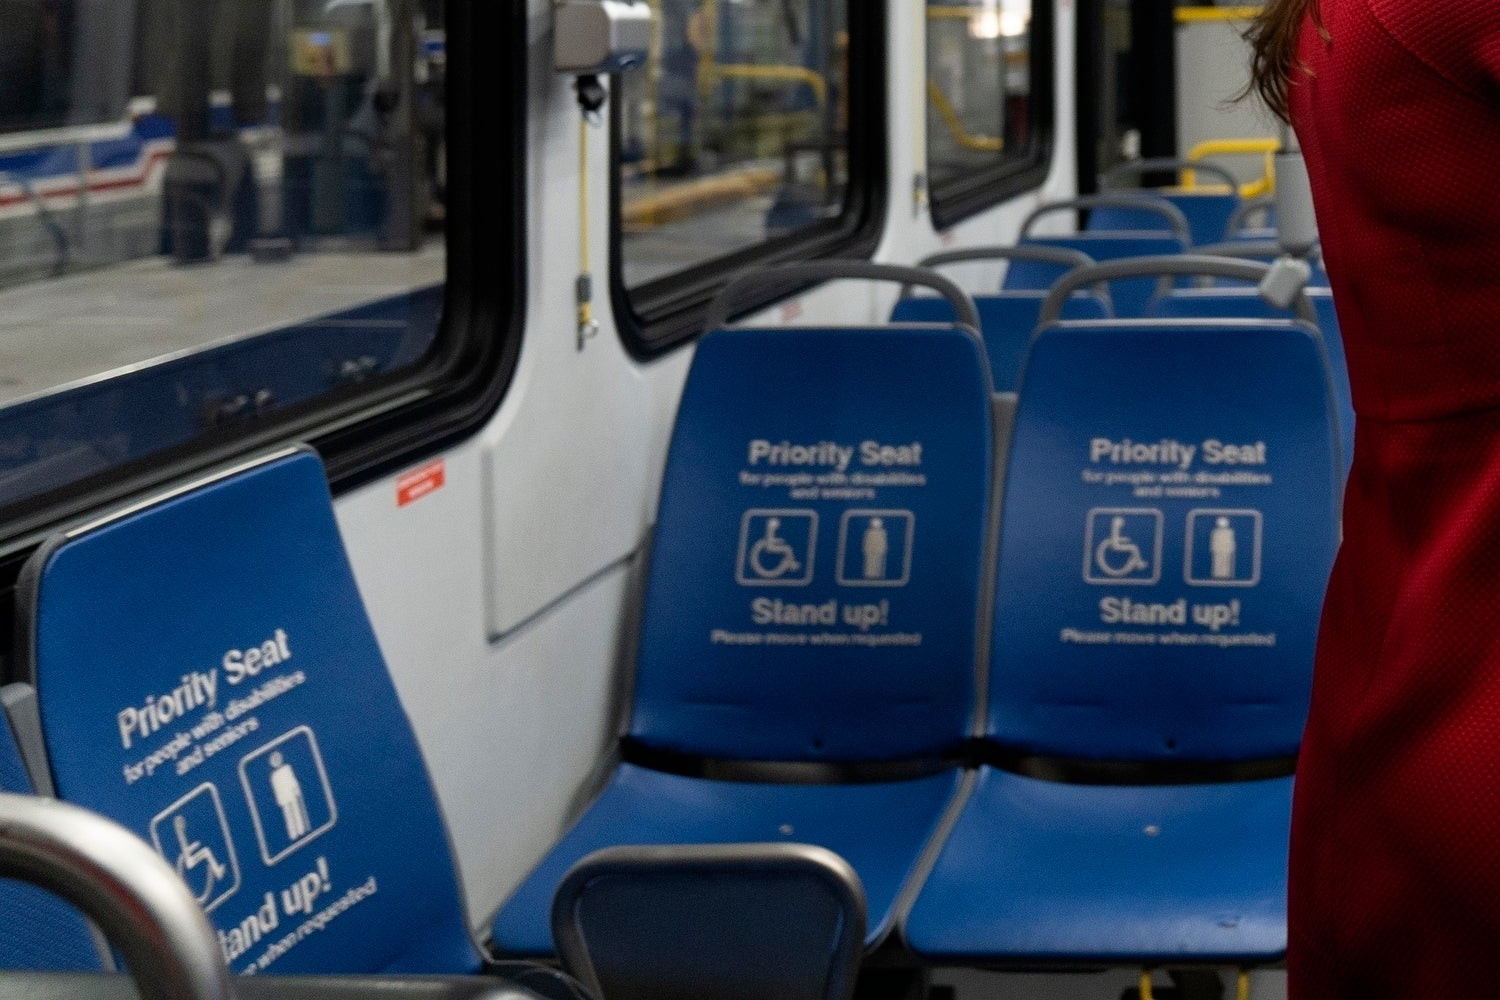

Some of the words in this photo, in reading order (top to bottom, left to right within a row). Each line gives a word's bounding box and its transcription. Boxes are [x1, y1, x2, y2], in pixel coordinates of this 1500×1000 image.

[749, 439, 853, 472] Priority
[859, 440, 922, 466] Seat
[1089, 437, 1196, 470] Priority
[1202, 438, 1267, 464] Seat
[751, 597, 837, 626] Stand
[842, 598, 890, 632] up!
[1100, 596, 1187, 625] Stand
[1192, 598, 1241, 632] up!
[117, 667, 218, 750] Priority
[222, 628, 291, 685] Seat
[123, 761, 145, 785] for
[144, 732, 192, 776] people
[190, 711, 225, 740] with
[224, 670, 306, 721] disabilities
[176, 745, 203, 776] and
[203, 716, 260, 758] seniors
[217, 891, 280, 966] tand
[281, 855, 332, 916] up!
[298, 876, 378, 942] requested
